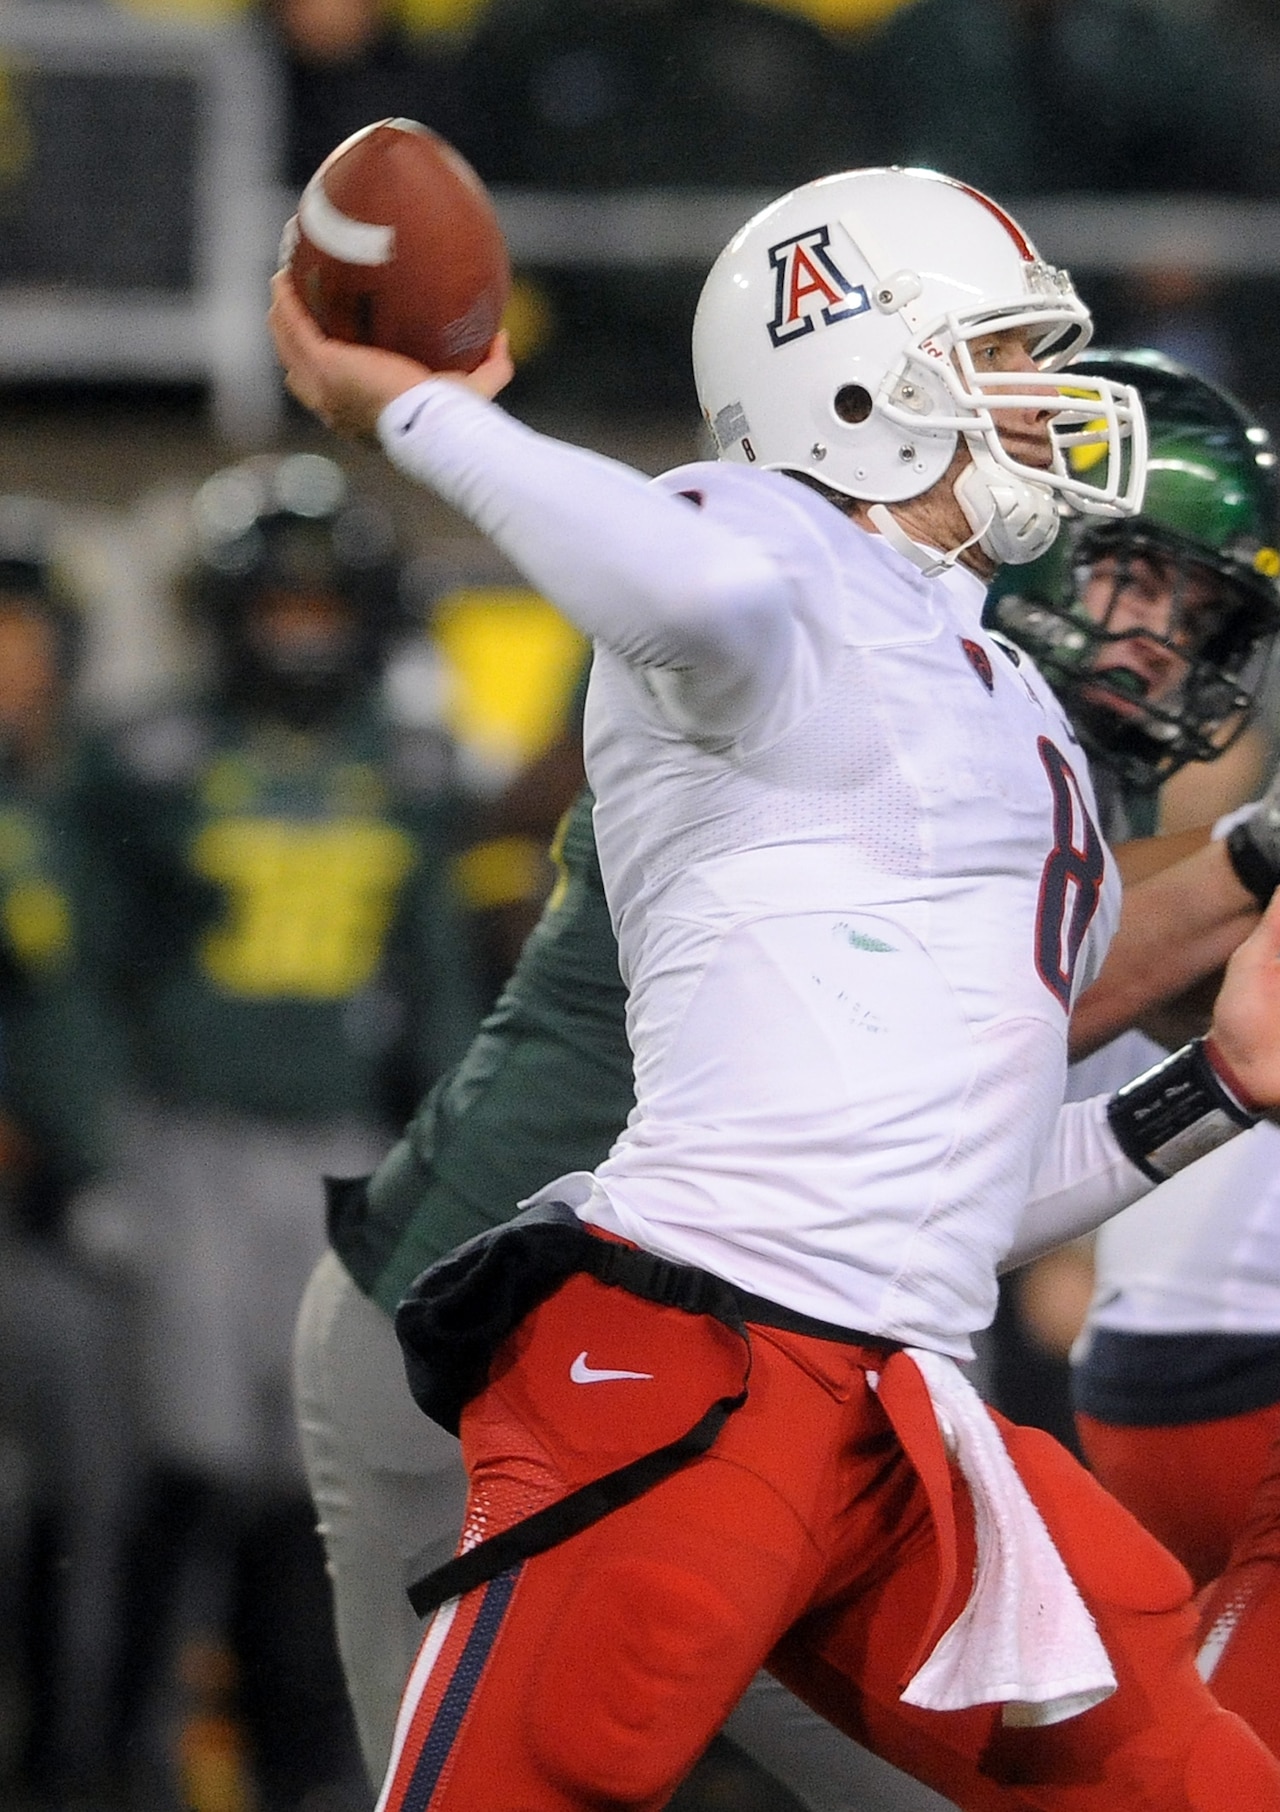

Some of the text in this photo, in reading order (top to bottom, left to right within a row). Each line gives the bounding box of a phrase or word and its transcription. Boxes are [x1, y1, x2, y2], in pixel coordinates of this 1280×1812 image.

[767, 224, 872, 349] A
[741, 437, 756, 462] 8
[1033, 735, 1104, 1018] 8
